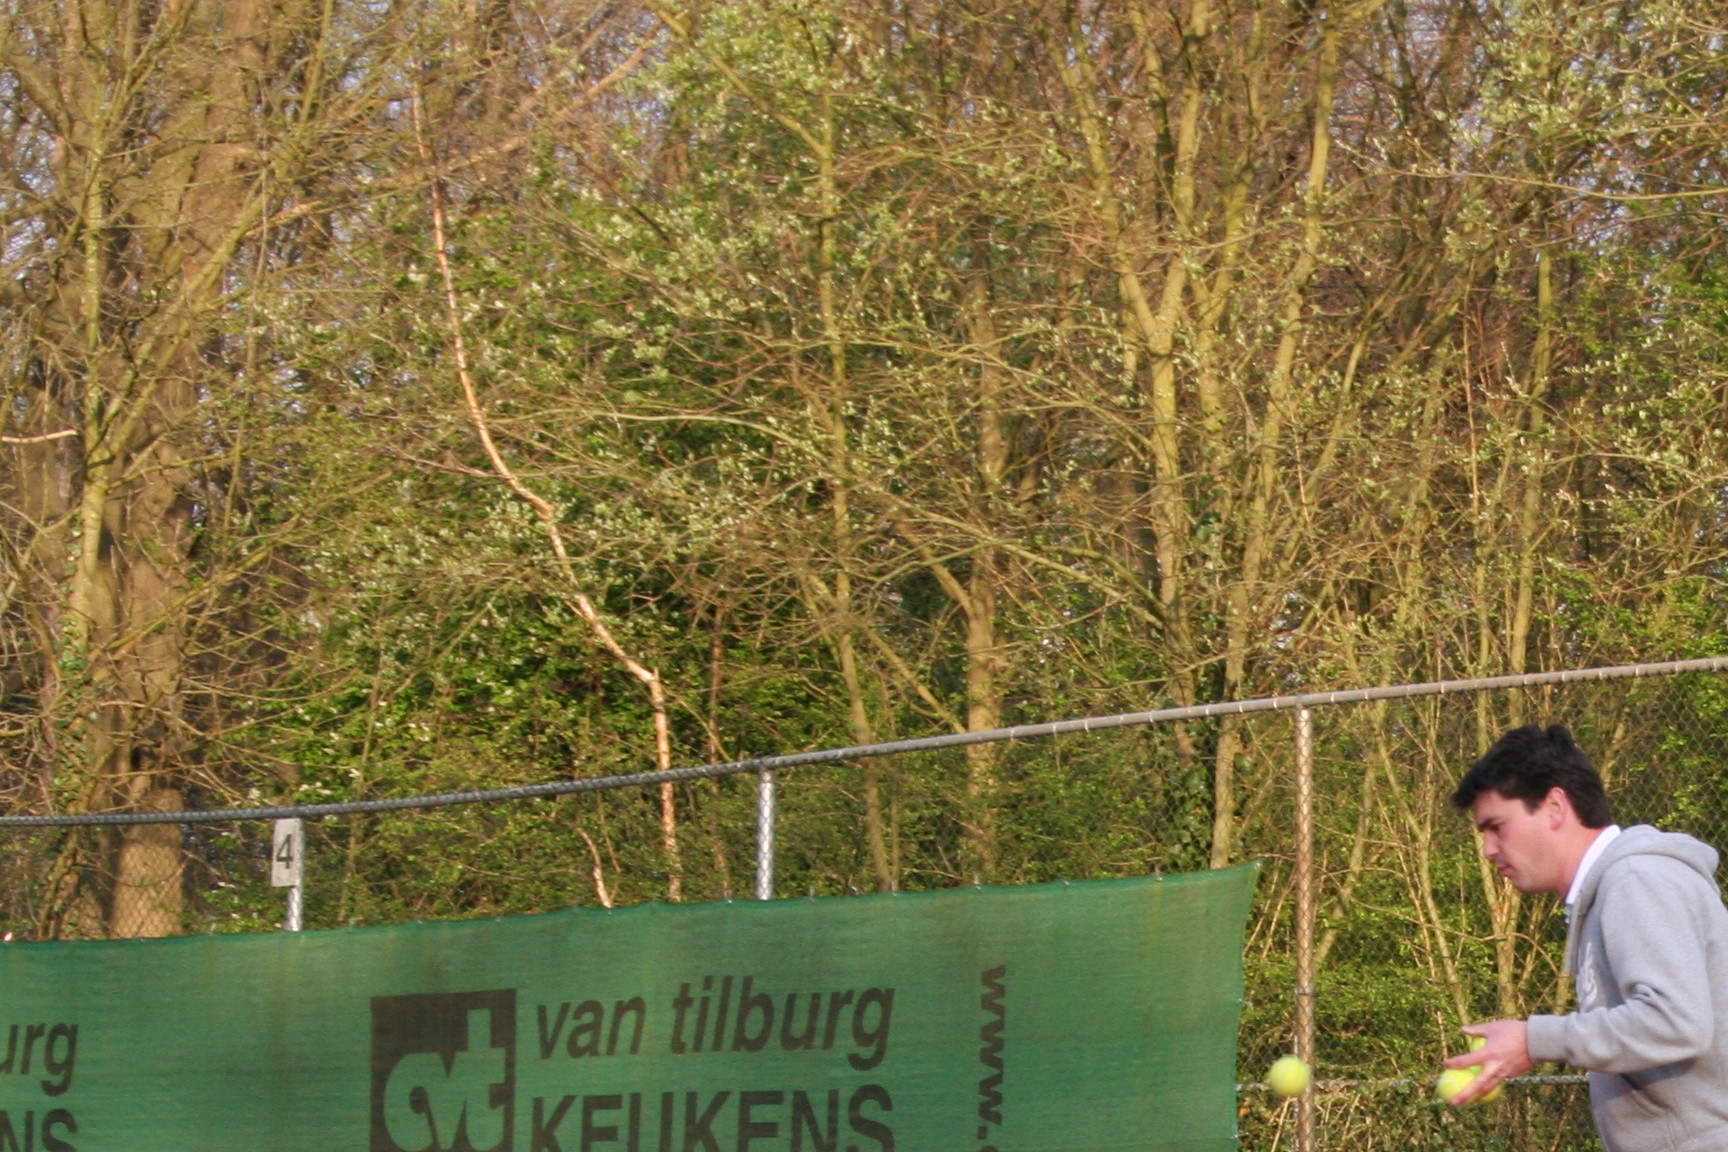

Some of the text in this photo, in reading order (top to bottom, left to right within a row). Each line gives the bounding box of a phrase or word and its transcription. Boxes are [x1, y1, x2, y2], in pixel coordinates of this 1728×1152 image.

[276, 833, 294, 869] 4
[536, 975, 896, 1071] van tilburg
